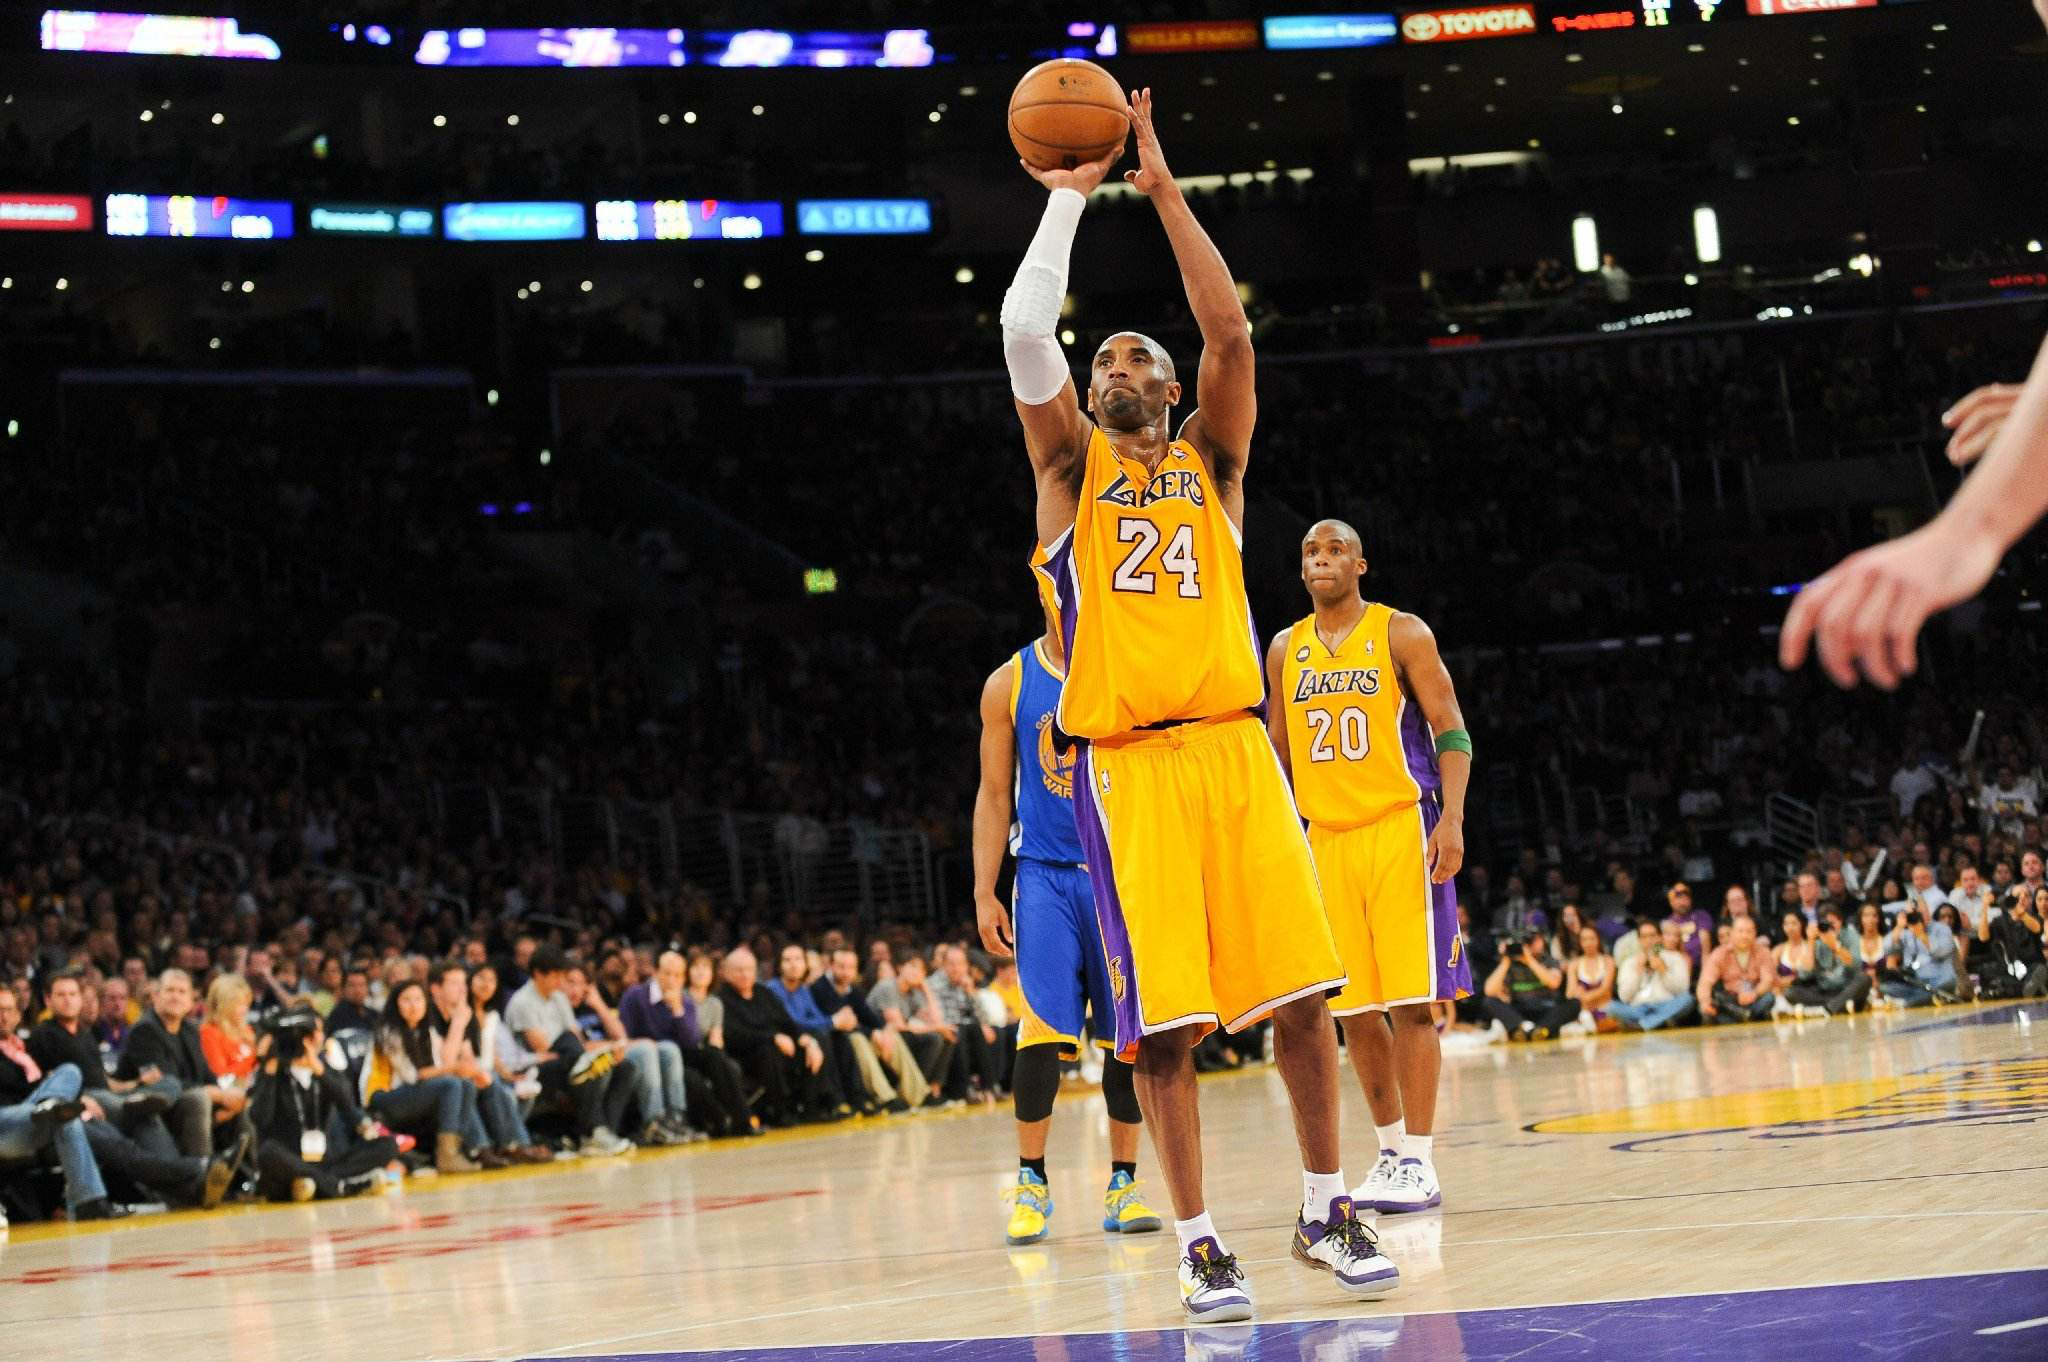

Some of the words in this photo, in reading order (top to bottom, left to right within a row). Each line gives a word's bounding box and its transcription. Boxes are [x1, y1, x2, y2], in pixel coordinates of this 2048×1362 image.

[1438, 8, 1535, 35] TOYOTA
[831, 205, 930, 230] DELTA
[1096, 470, 1205, 508] LAKERS
[1112, 516, 1202, 600] 24
[1292, 666, 1380, 704] LAKERS
[1035, 704, 1058, 730] GOL
[1305, 705, 1371, 763] 20
